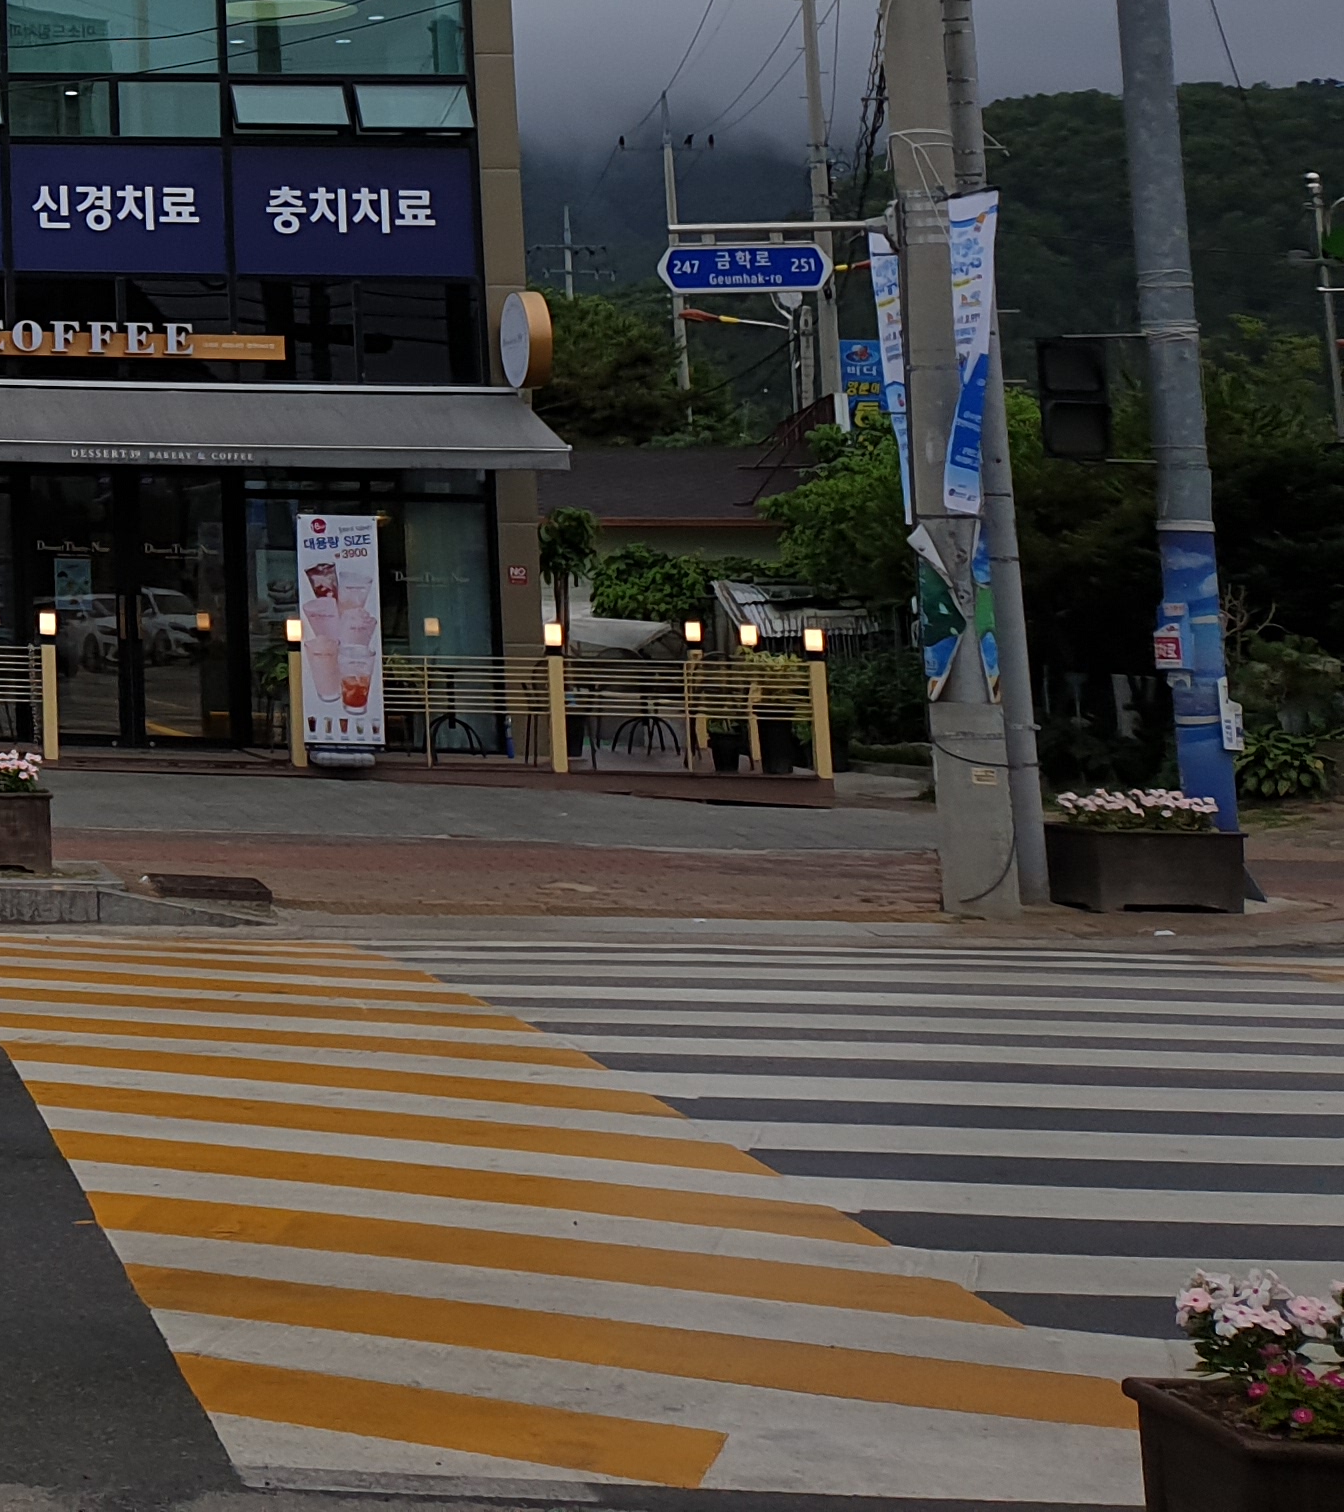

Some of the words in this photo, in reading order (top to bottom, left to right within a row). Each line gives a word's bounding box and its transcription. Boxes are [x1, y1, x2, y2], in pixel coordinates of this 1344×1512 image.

[31, 183, 201, 232] 신경치료
[265, 185, 437, 235] 충치치료
[673, 260, 700, 275] 247
[714, 250, 772, 270] 금학로
[790, 257, 817, 273] 251
[709, 273, 784, 285] Geumhak-ro
[211, 452, 254, 461] COFFEE
[303, 536, 339, 550] 대용량
[344, 534, 372, 547] SIZE
